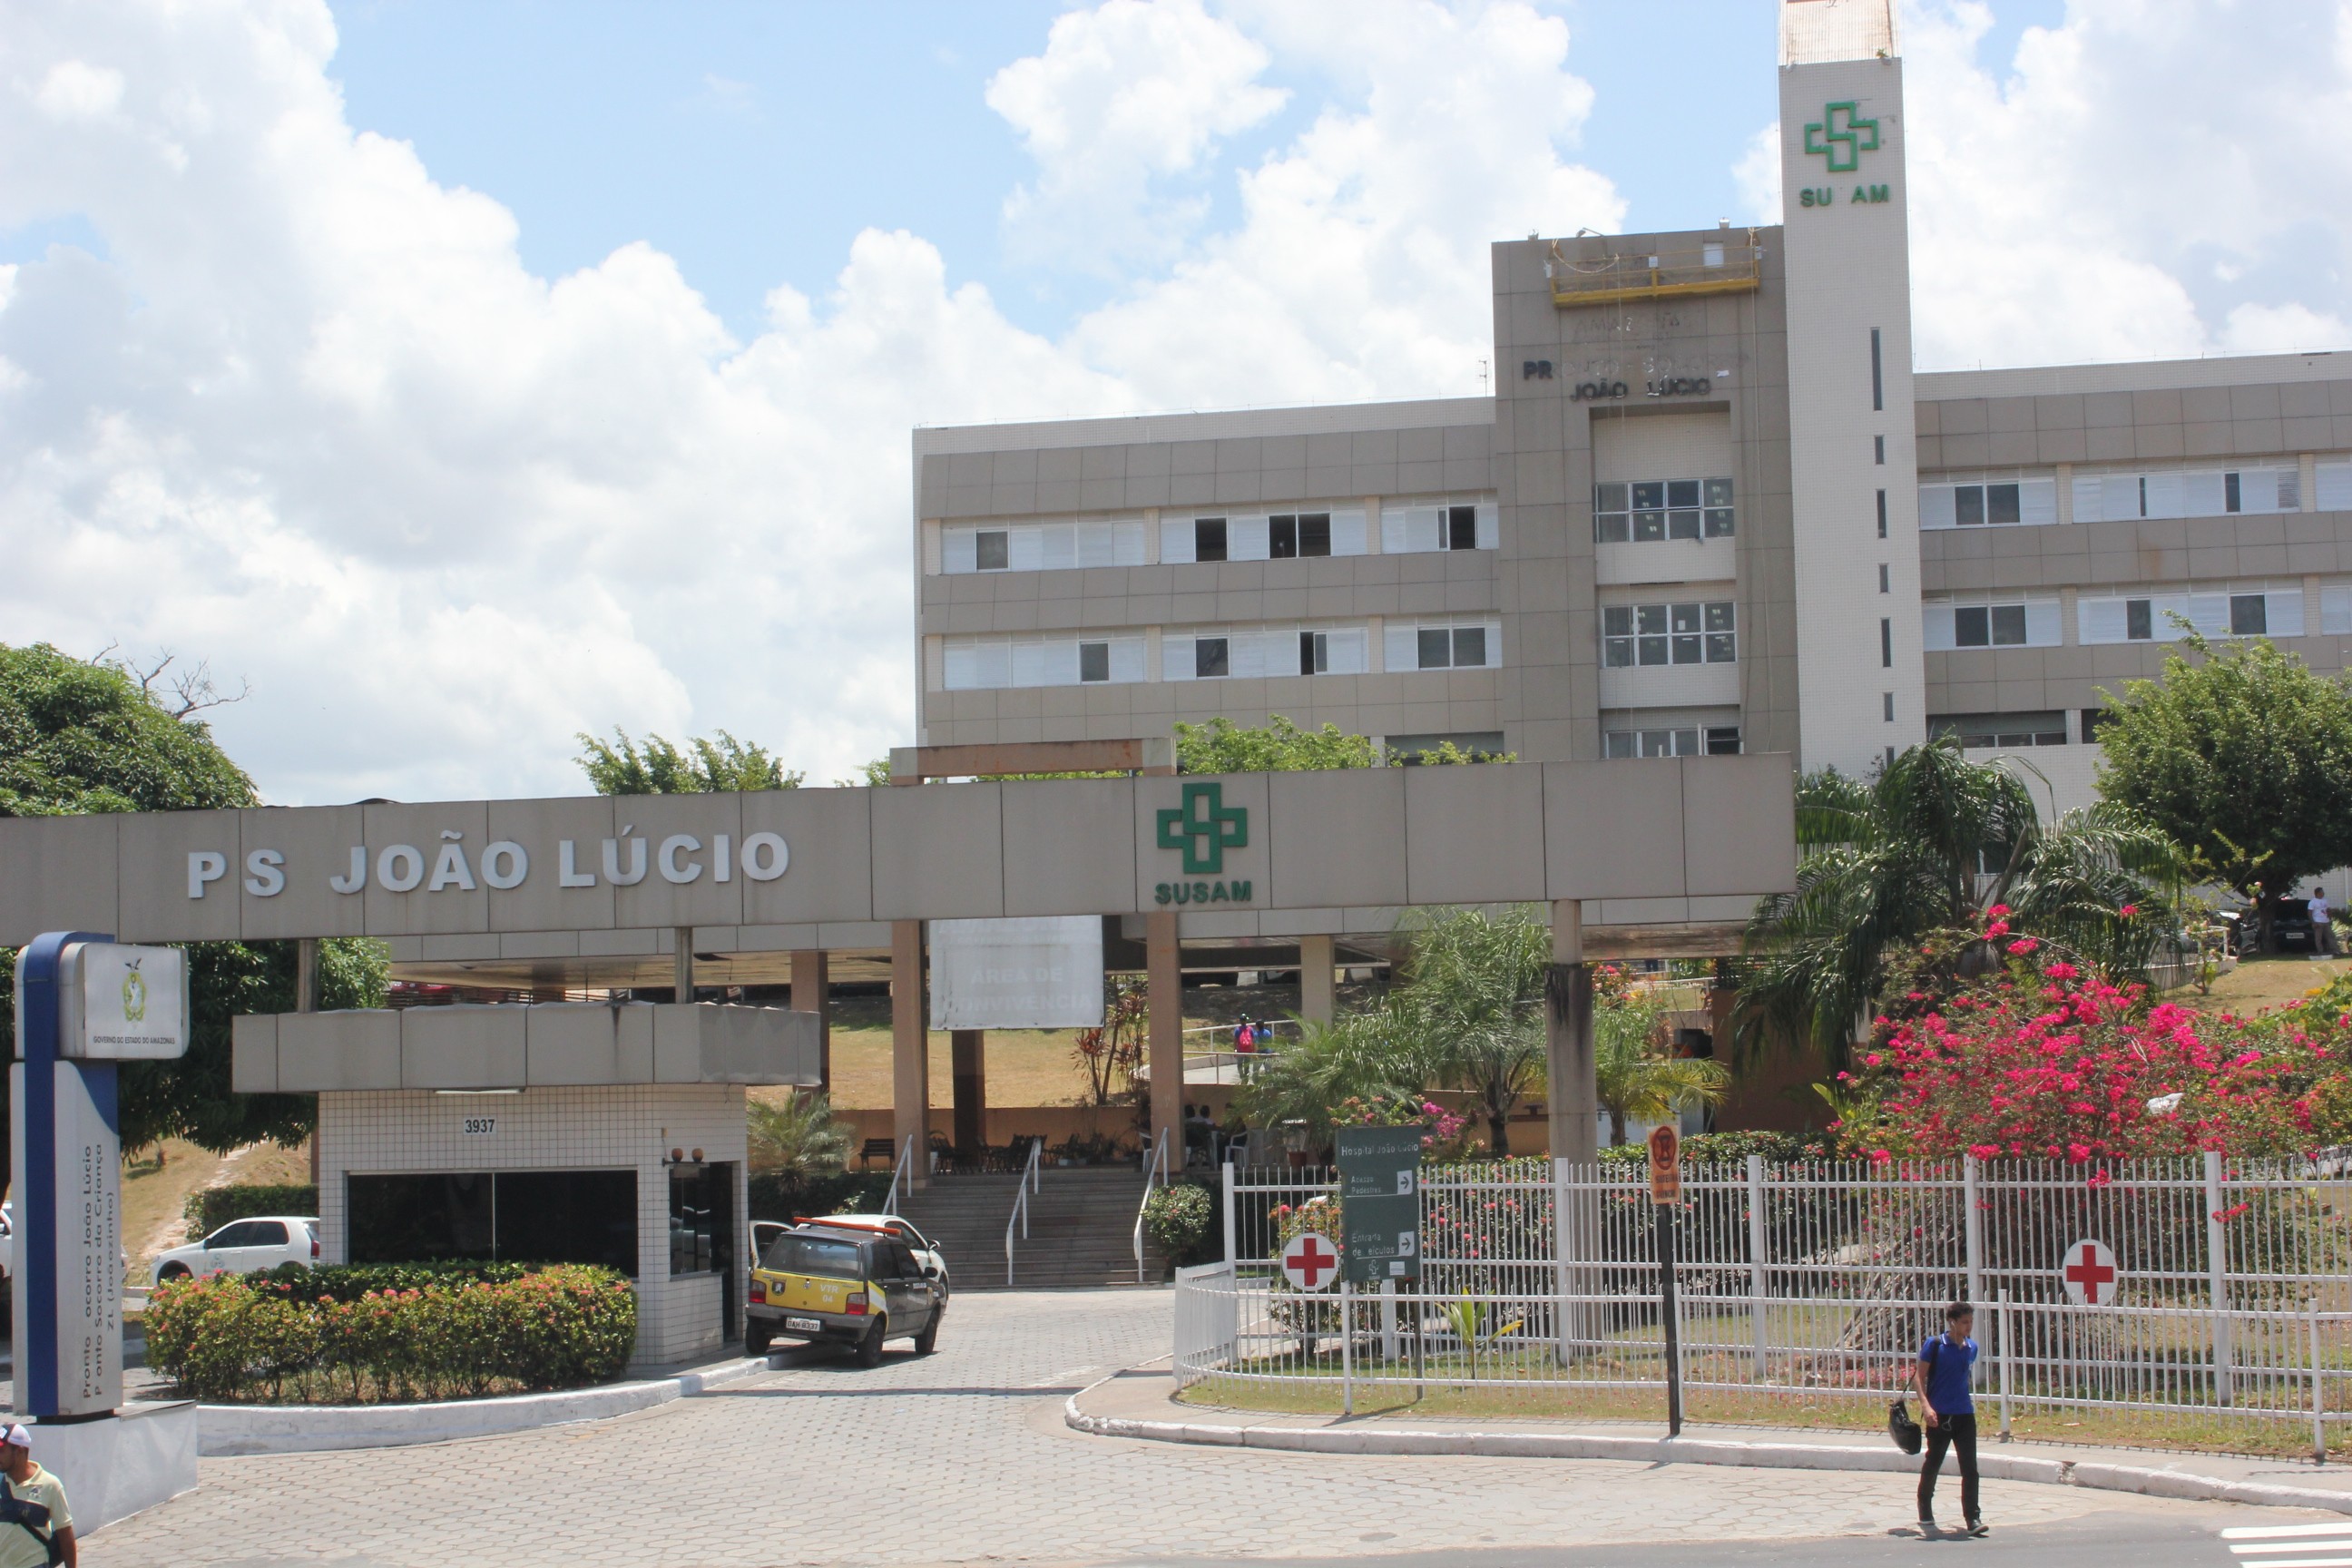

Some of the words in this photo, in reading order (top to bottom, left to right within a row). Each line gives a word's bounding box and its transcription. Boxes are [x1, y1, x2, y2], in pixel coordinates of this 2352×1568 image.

[1570, 377, 1628, 401] JOÃO
[187, 848, 287, 899] PS
[329, 829, 530, 895] JOÃO
[558, 824, 791, 889] LÚCIO
[1154, 880, 1251, 904] SUSAM
[93, 1035, 116, 1044] GOVERNO
[465, 1119, 495, 1133] 3937
[1341, 1146, 1374, 1157] Hospital
[1377, 1142, 1396, 1154] João
[83, 1146, 92, 1194] Lúcio
[94, 1144, 103, 1217] Criança
[1351, 1186, 1382, 1194] Pedestres
[83, 1202, 92, 1248] João
[94, 1225, 102, 1248] da
[1352, 1233, 1381, 1243] Entrada
[1352, 1247, 1361, 1257] de
[94, 1255, 103, 1328] Socorro
[819, 1283, 838, 1294] VTR
[822, 1294, 833, 1304] 04
[108, 1309, 114, 1331] ZL
[83, 1337, 91, 1398] Pronto
